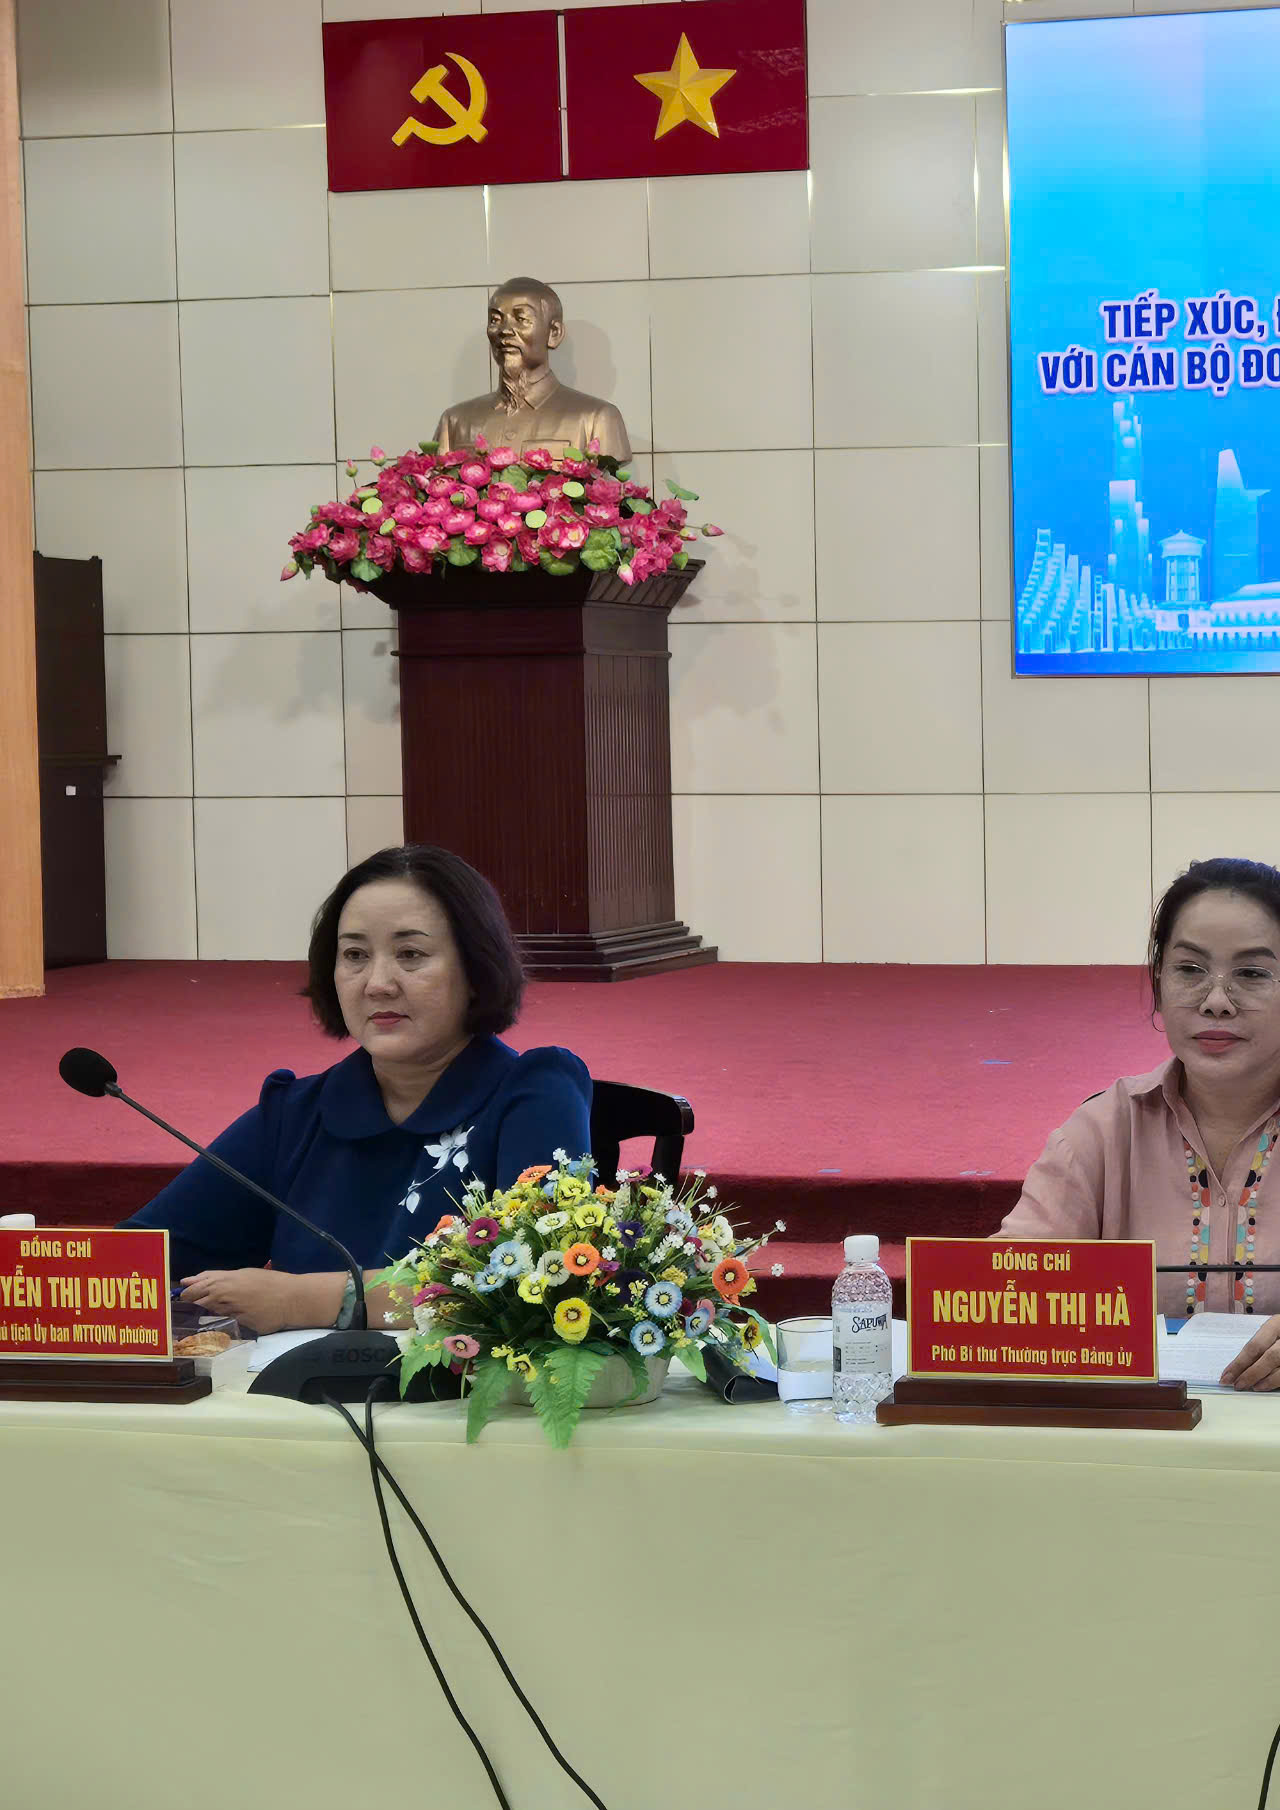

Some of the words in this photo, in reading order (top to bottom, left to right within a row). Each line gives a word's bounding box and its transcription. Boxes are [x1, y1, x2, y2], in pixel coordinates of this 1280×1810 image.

[1103, 292, 1176, 338] TIẾP
[1187, 294, 1265, 338] XÚC,
[1041, 348, 1094, 389] VỚI
[1106, 345, 1175, 388] CÁN
[1187, 343, 1231, 392] BỘ
[48, 1276, 81, 1315] THỊ
[87, 1271, 158, 1310] DUYÊN
[933, 1279, 1038, 1325] NGUYỄN
[1046, 1292, 1086, 1332] THỊ
[1095, 1286, 1131, 1326] HÀ
[50, 1323, 70, 1343] ban
[73, 1324, 117, 1344] MTTQVN
[932, 1344, 956, 1362] Phó
